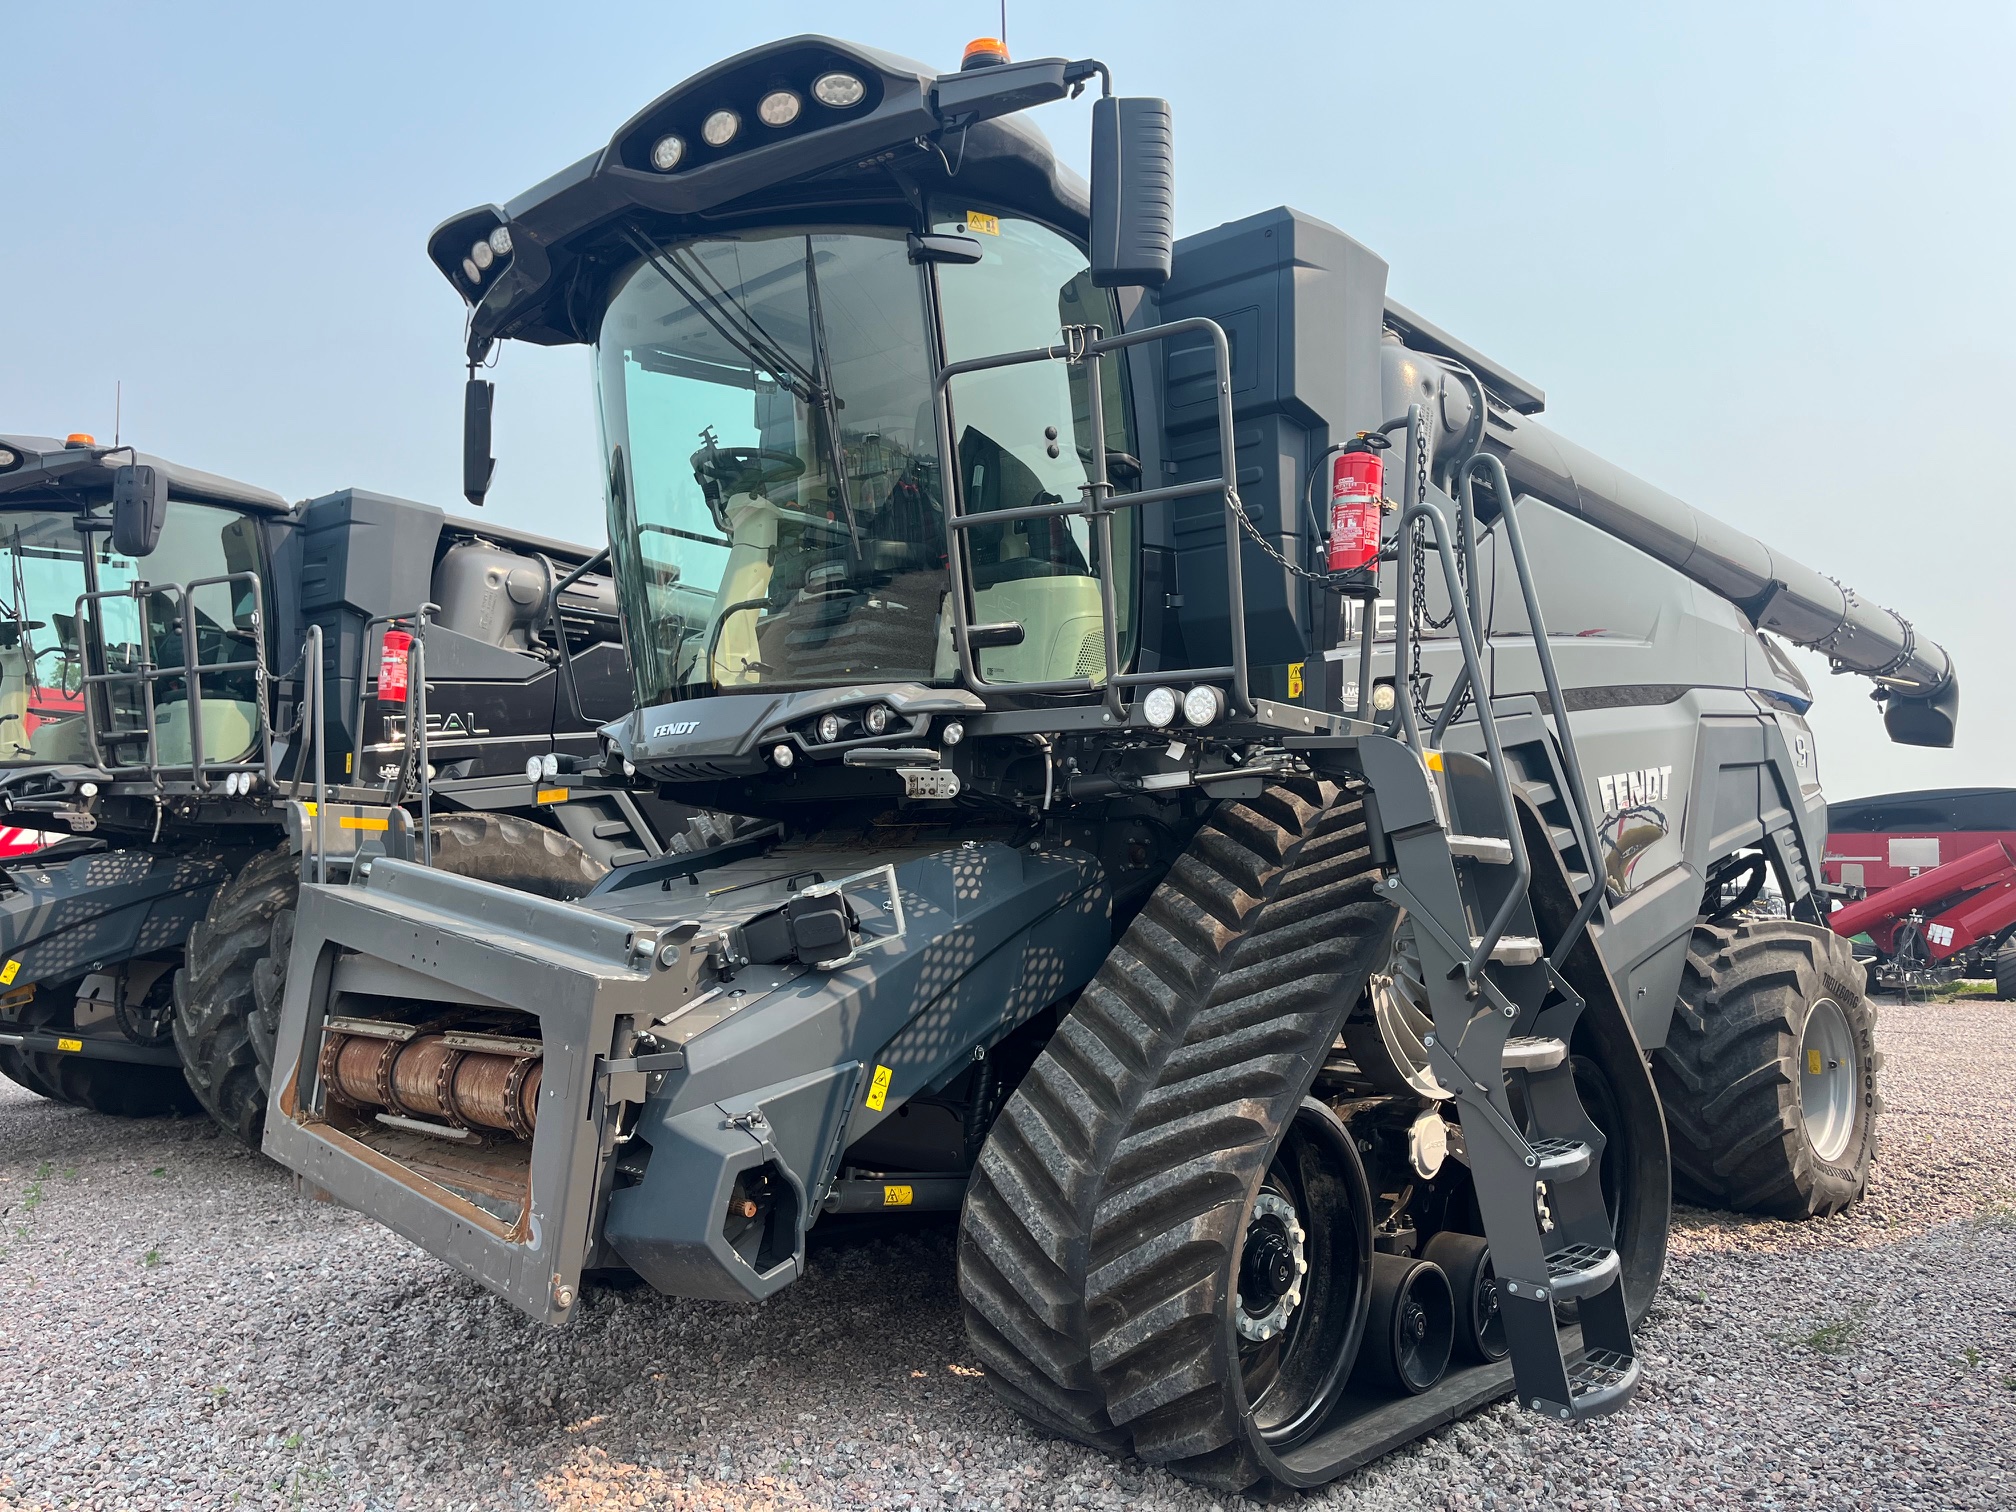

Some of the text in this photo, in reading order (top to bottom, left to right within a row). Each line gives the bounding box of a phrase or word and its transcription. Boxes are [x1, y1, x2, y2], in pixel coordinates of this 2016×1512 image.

[1340, 599, 1436, 635] IDEL
[653, 721, 701, 738] FENDT
[1597, 765, 1672, 814] FENDT
[1821, 972, 1859, 1009] TRELLEBORG
